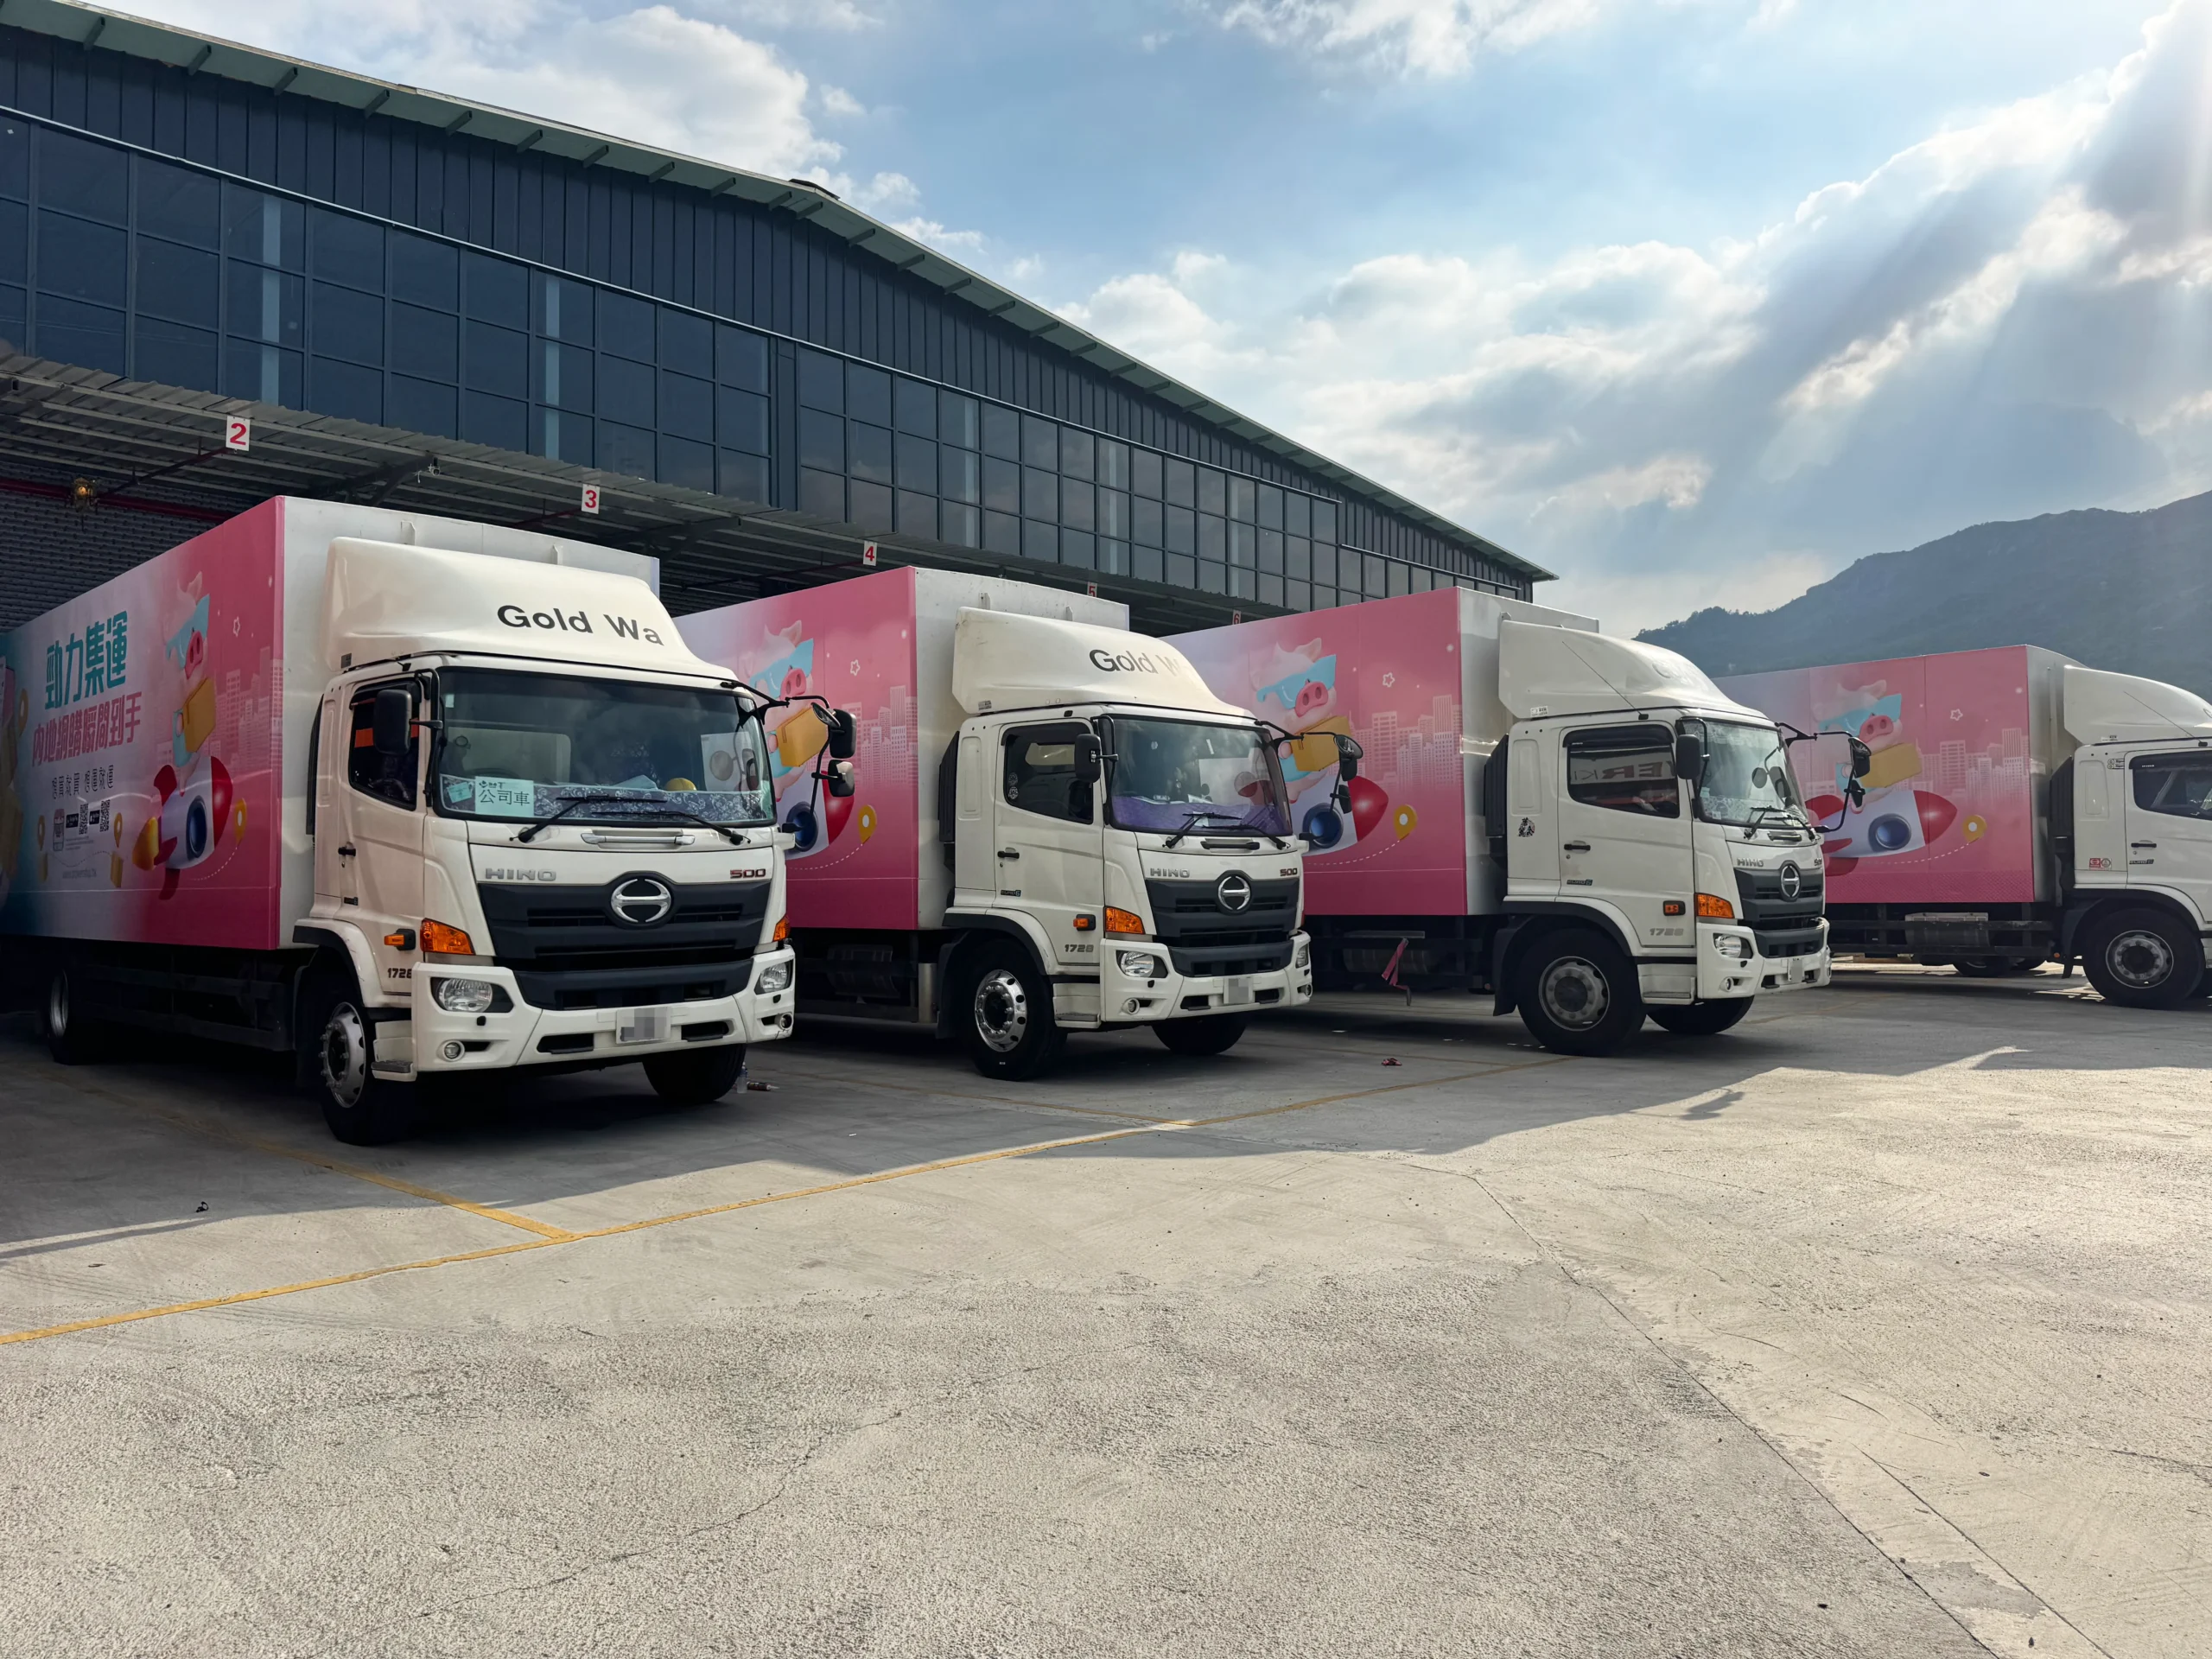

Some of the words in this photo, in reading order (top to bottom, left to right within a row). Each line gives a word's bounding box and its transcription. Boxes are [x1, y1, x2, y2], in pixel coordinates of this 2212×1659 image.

[230, 423, 247, 446] 2
[585, 489, 597, 508] 3
[865, 545, 874, 562] 4
[1089, 585, 1096, 598] 5
[497, 605, 594, 633] Gold
[603, 614, 664, 645] Wa
[1234, 613, 1240, 625] 6
[45, 610, 128, 710] 勁力集運
[1089, 649, 1159, 674] Gold
[32, 691, 143, 767] 內地網購瞬間到手
[478, 789, 530, 806] 公司車
[1737, 858, 1764, 868] HINO
[486, 868, 556, 881] HINO
[730, 868, 766, 879] 500
[1150, 868, 1191, 879] HINO
[1280, 868, 1298, 877] 500
[1065, 944, 1094, 952] 1728
